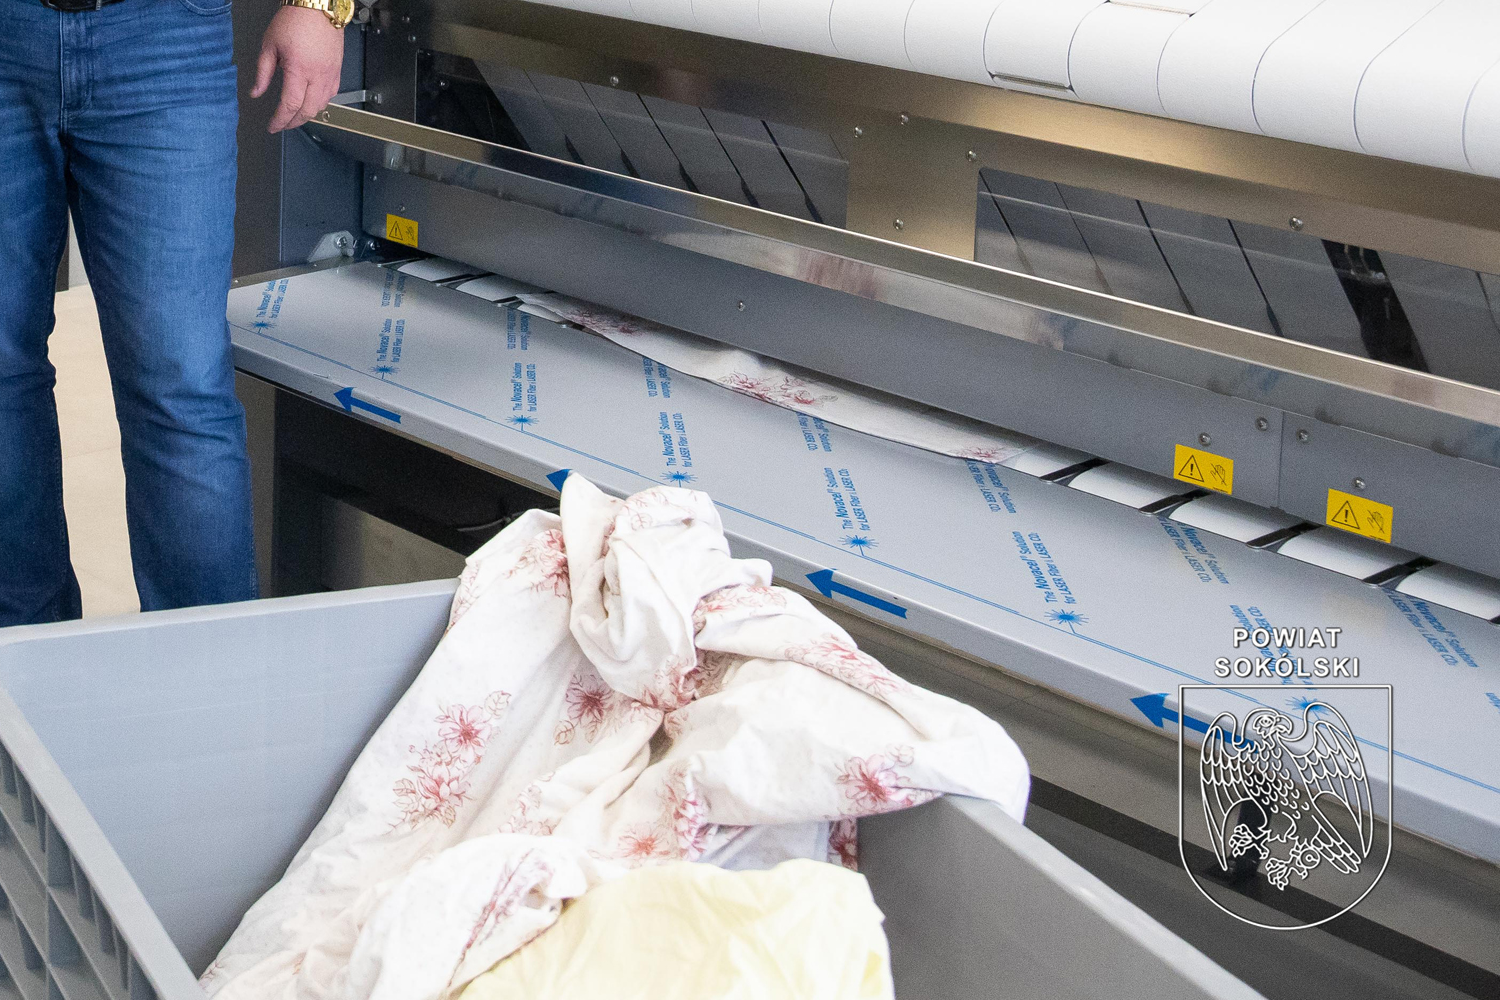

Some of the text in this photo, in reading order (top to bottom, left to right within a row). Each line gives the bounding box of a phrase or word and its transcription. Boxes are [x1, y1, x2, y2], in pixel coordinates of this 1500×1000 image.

[659, 412, 670, 430] Solution
[666, 457, 676, 466] The
[824, 467, 838, 488] Solution
[998, 492, 1016, 514] Solution
[842, 519, 853, 529] The
[1013, 532, 1032, 554] Solution
[1033, 542, 1051, 559] LASER
[1160, 521, 1182, 539] LASER
[1185, 555, 1205, 573] LASER
[1047, 563, 1059, 577] Fiber
[1205, 559, 1230, 585] Solution
[1052, 578, 1072, 595] LASER
[1045, 591, 1057, 603] The
[1064, 595, 1076, 604] for
[1387, 594, 1414, 614] LASER
[1423, 633, 1449, 654] LASER
[1447, 639, 1478, 668] Solution
